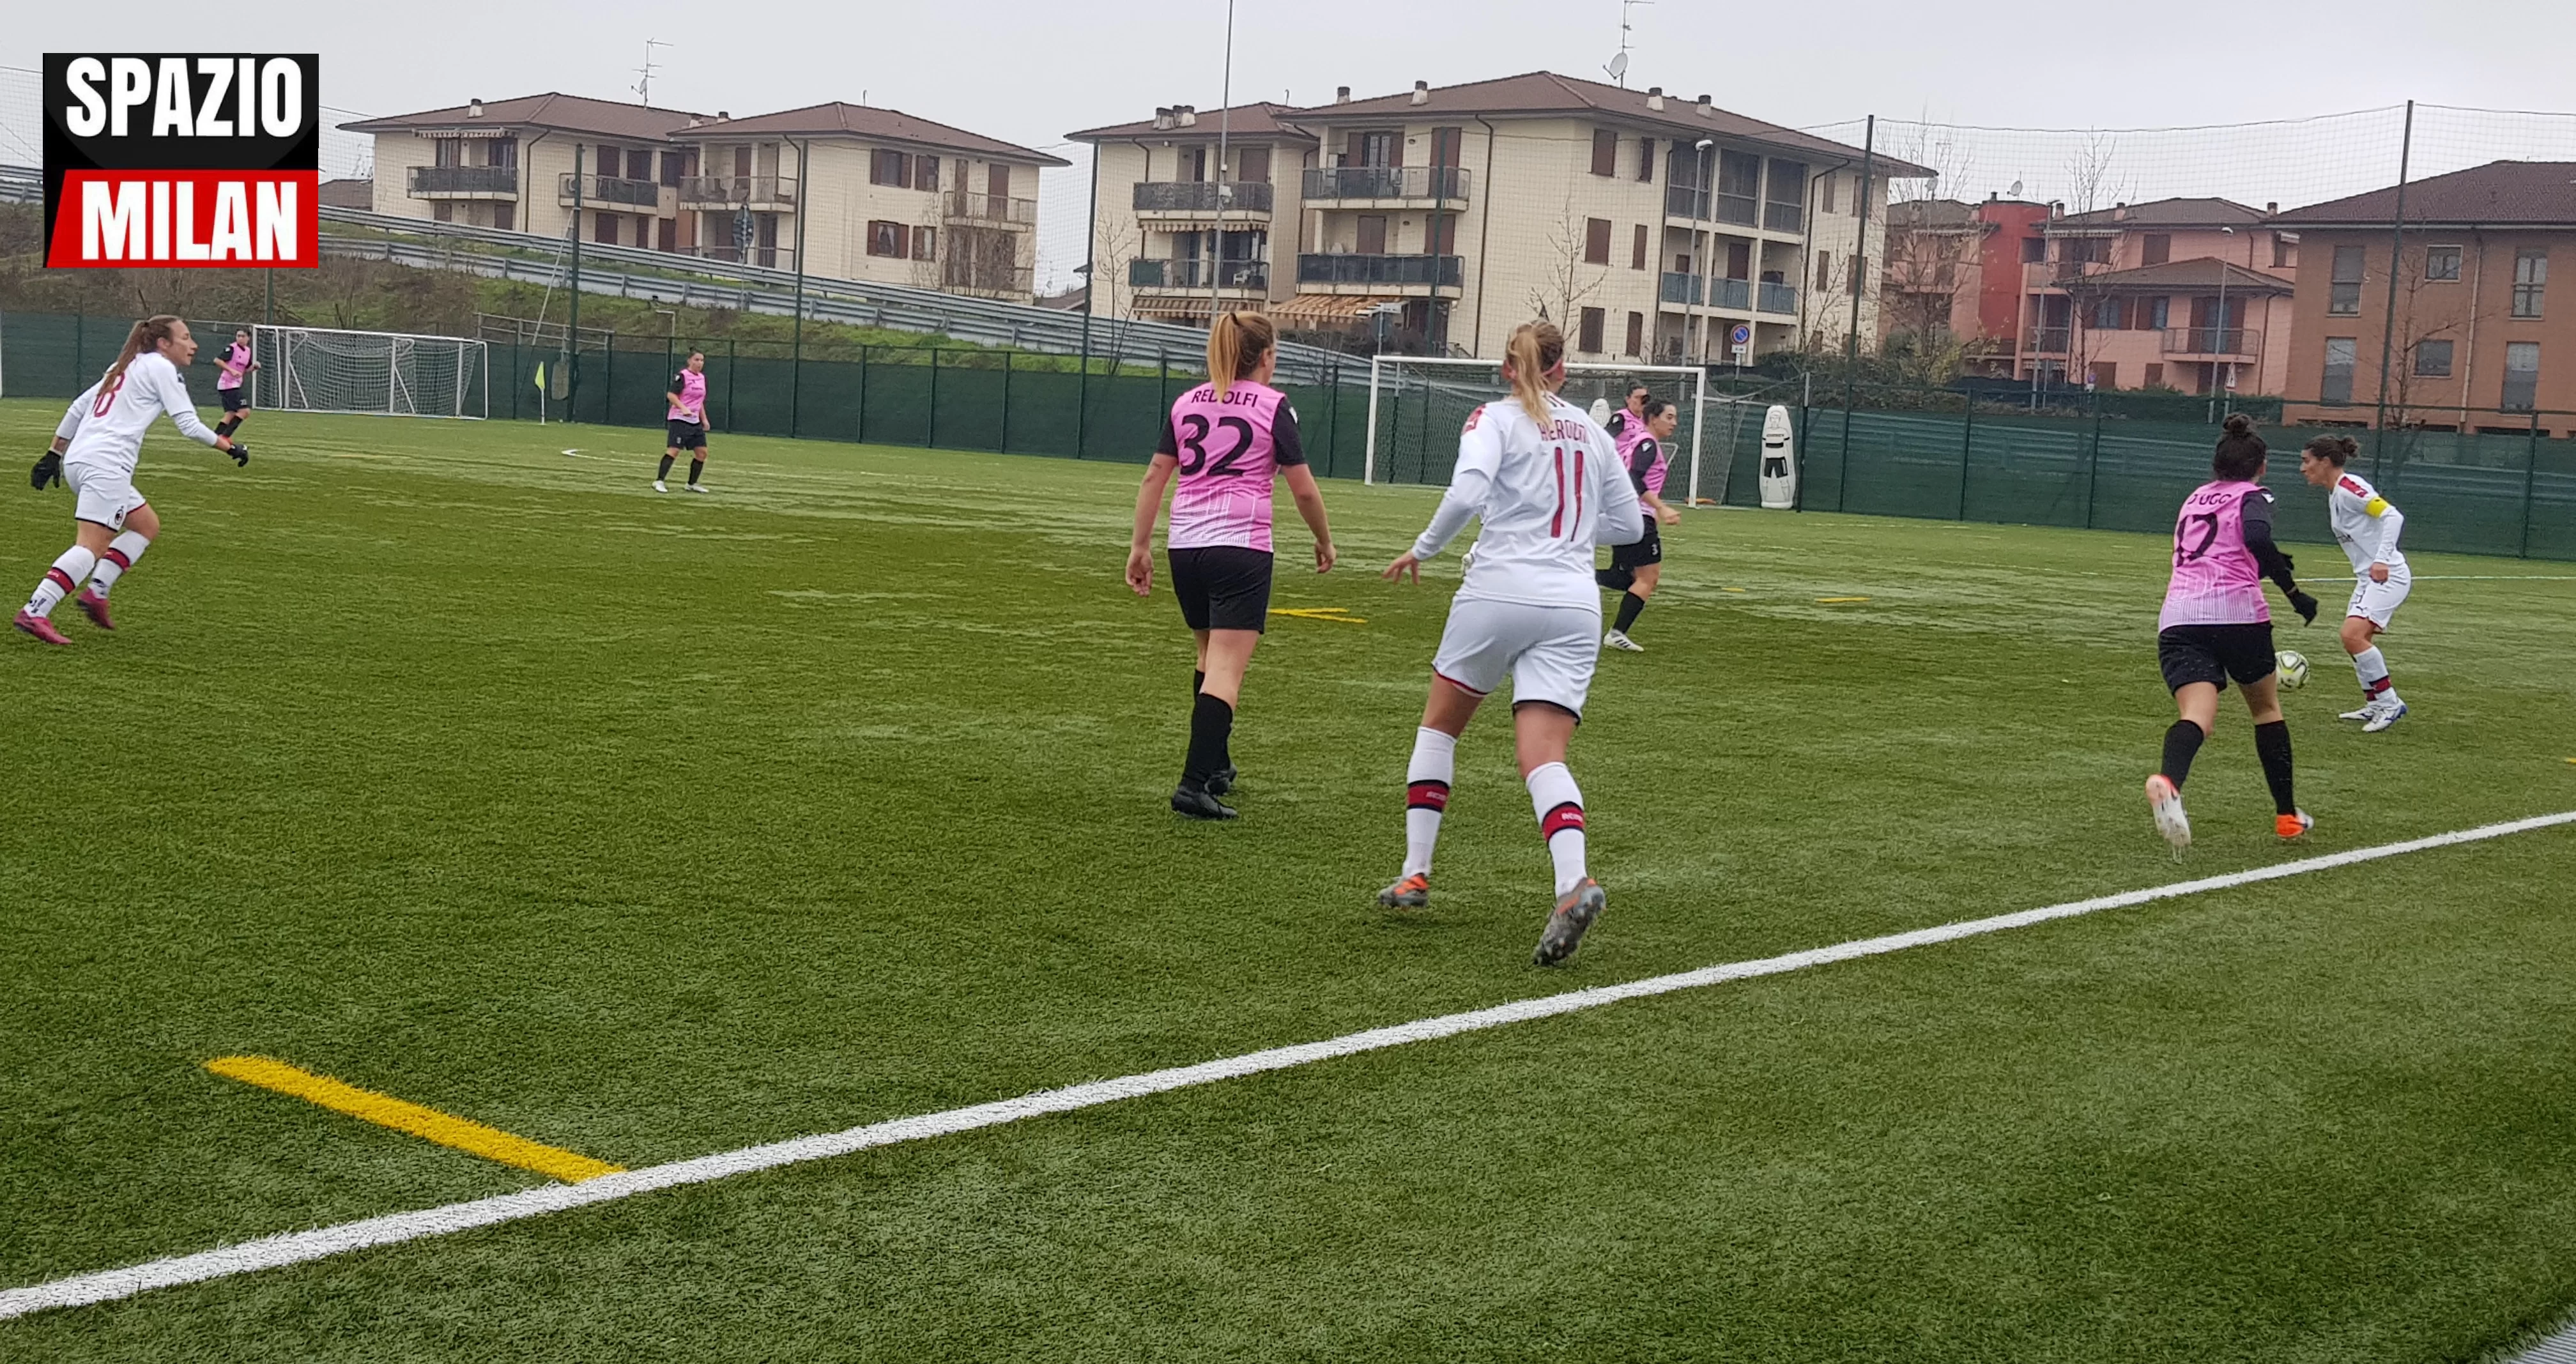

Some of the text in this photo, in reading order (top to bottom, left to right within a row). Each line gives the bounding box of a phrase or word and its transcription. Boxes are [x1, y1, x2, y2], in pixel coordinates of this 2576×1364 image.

[1191, 388, 1258, 408] REDOLFI
[1179, 413, 1254, 477] 32
[1551, 447, 1583, 542] 11
